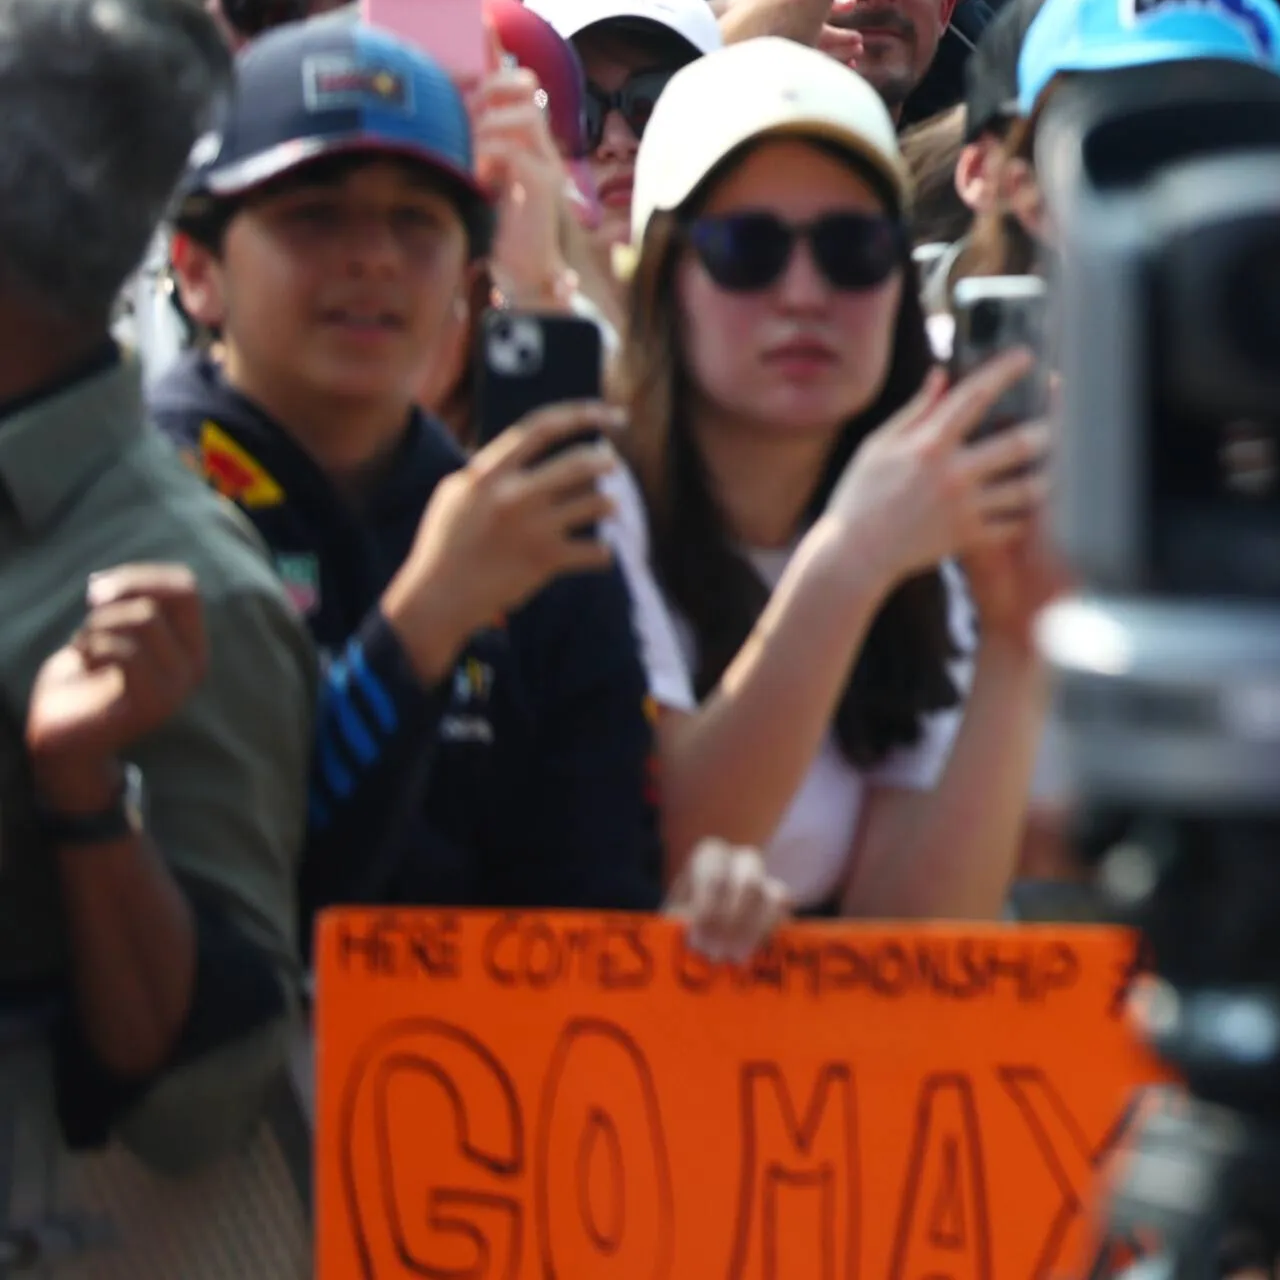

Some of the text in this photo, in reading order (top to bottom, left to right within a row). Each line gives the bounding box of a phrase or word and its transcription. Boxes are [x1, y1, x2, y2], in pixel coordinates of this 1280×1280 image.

[337, 914, 460, 979] HERE
[483, 915, 654, 990] COMES
[340, 1015, 1135, 1280] GO MAX
